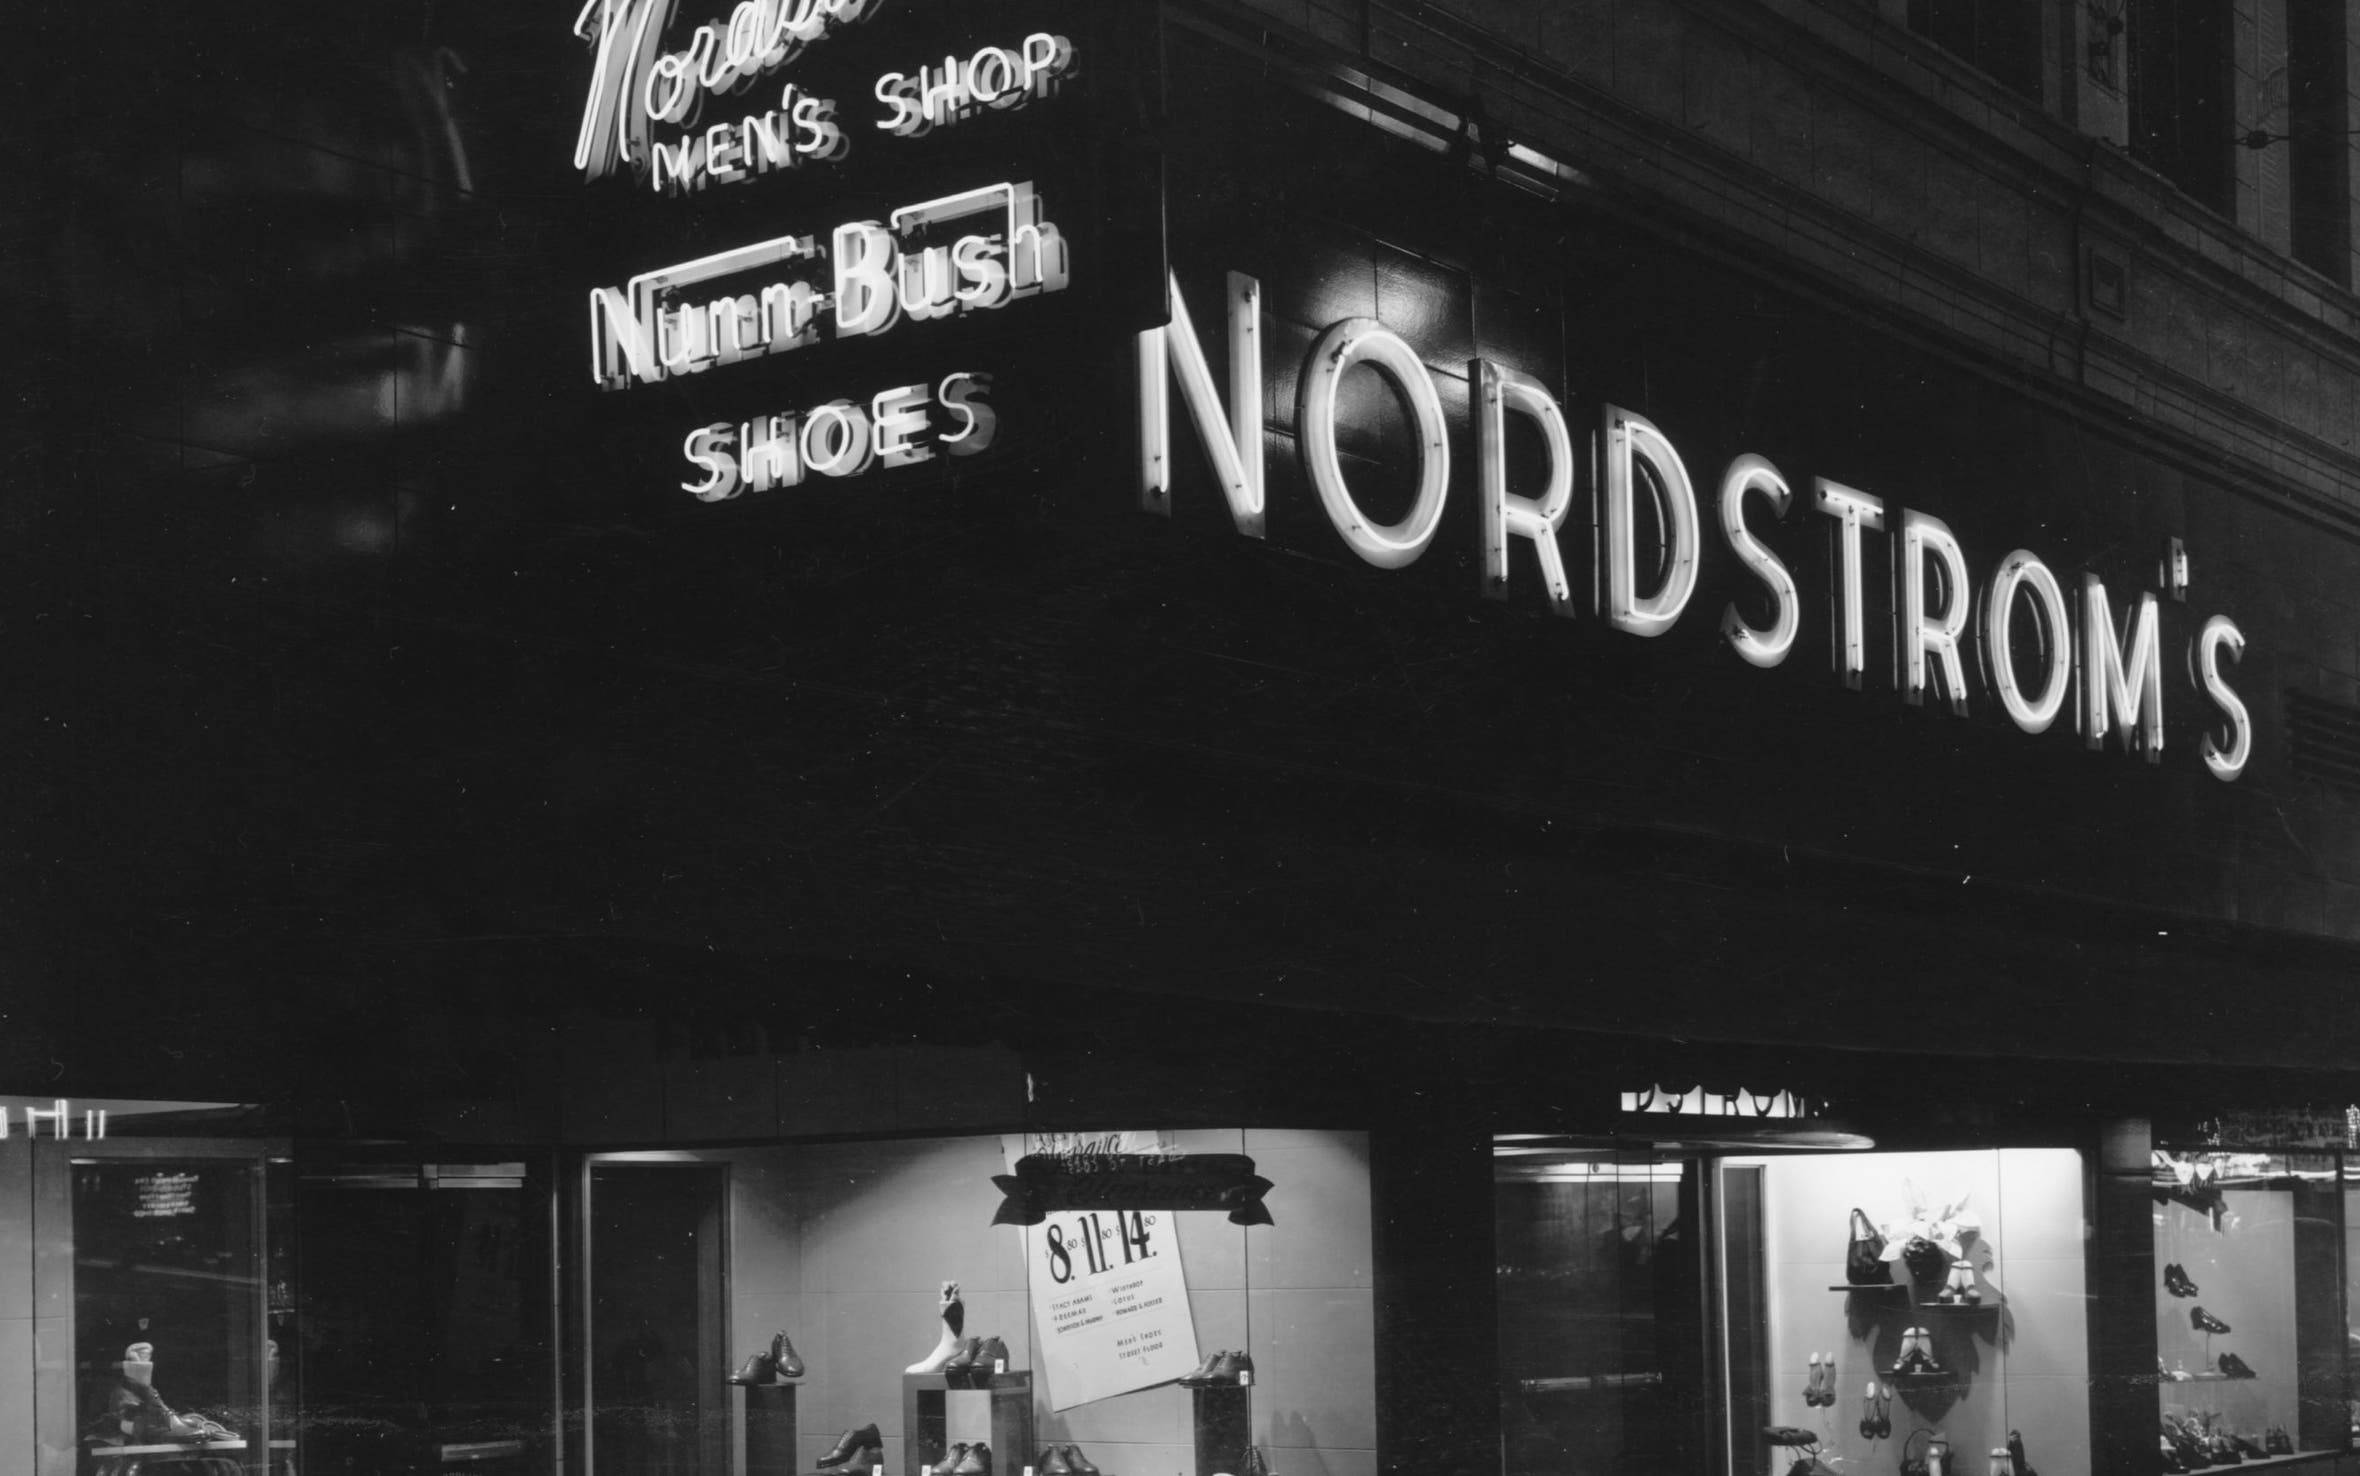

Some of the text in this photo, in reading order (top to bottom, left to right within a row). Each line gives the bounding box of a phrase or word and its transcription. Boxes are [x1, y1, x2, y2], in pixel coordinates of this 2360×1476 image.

[653, 33, 1077, 197] MEN'S SHOP
[590, 181, 1069, 391] Nunn-Bush
[681, 372, 996, 502] SHOES
[1137, 265, 2251, 782] NORDSTROM'S
